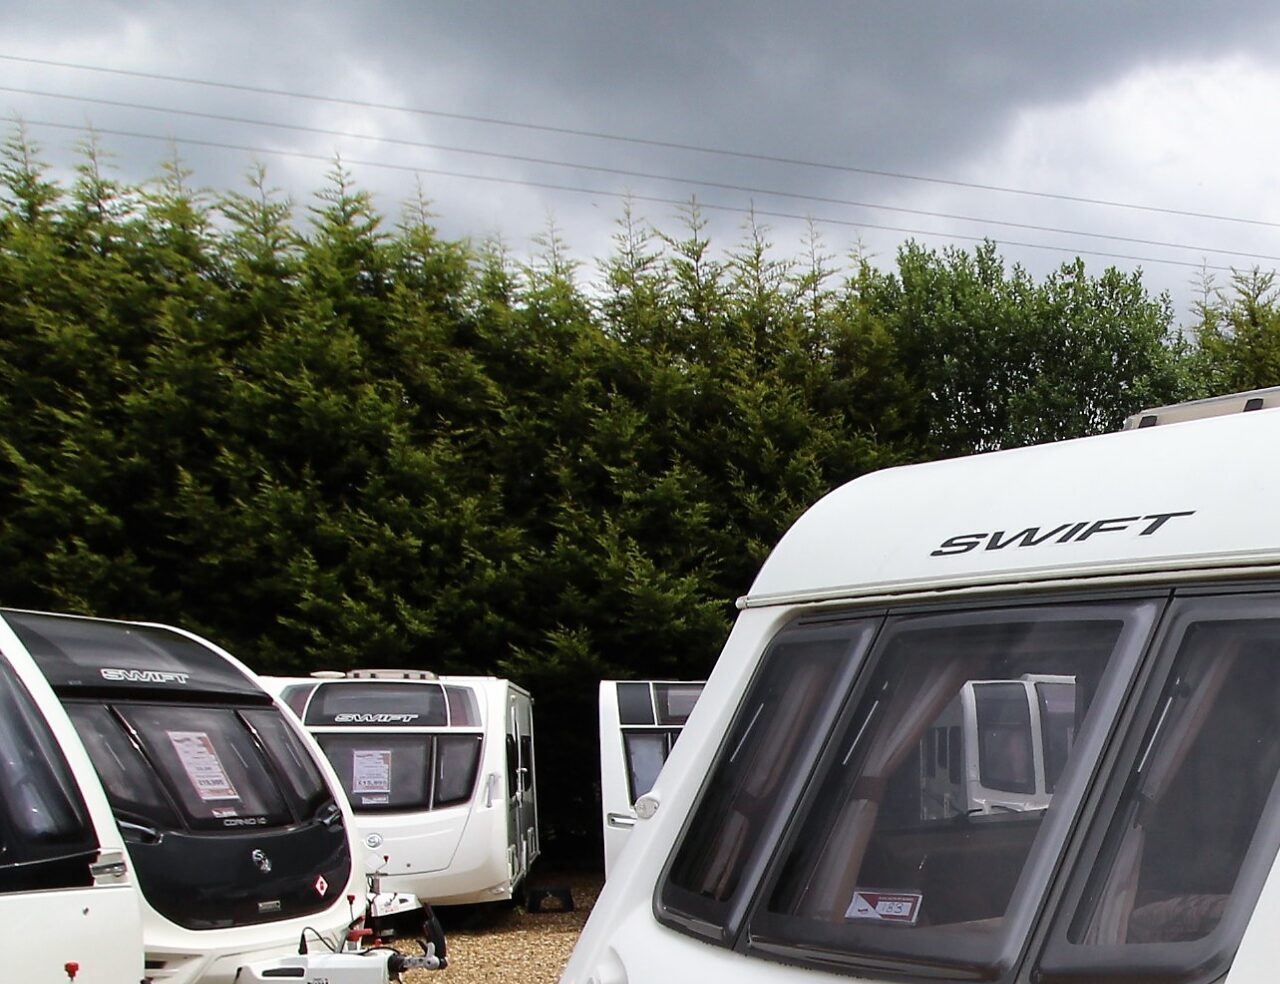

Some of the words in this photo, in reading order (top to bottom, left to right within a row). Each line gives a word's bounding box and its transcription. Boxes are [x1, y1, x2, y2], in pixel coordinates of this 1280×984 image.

[929, 510, 1197, 557] SWIFT
[100, 668, 190, 684] SWIFT
[334, 713, 419, 722] SWIFT
